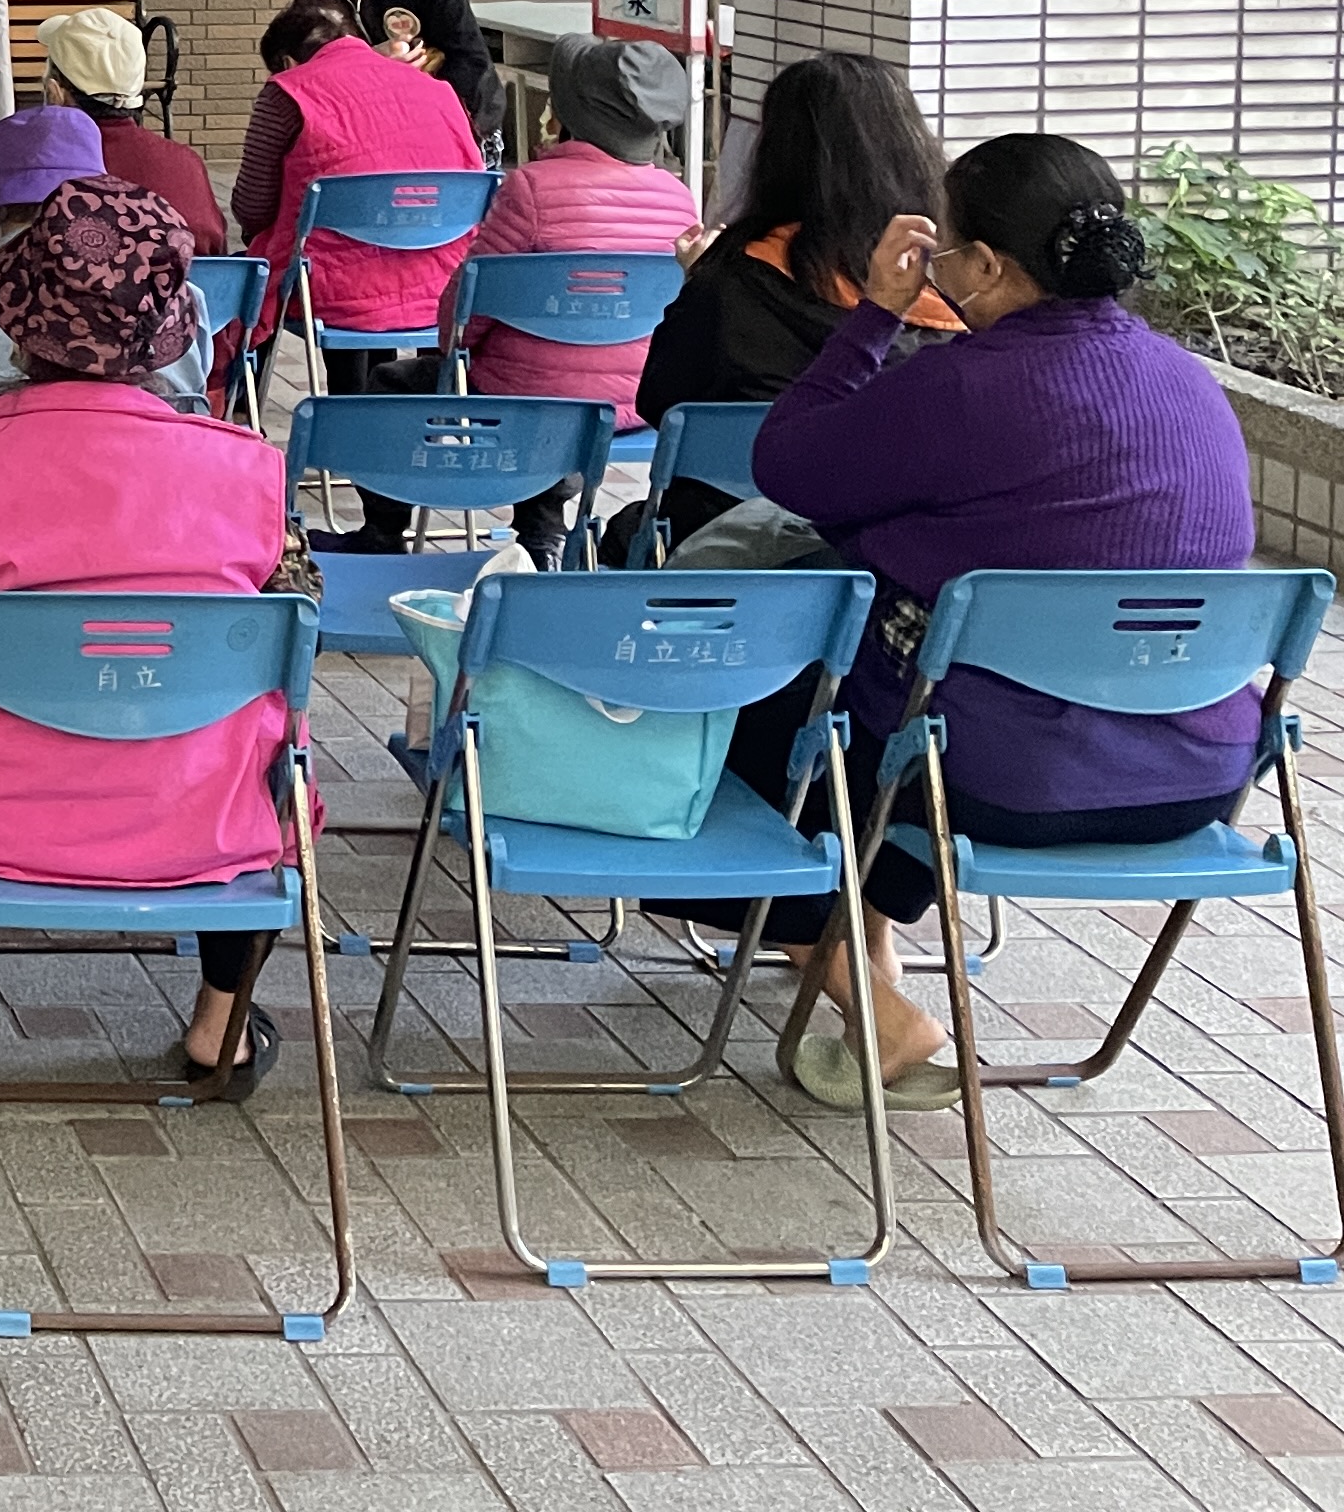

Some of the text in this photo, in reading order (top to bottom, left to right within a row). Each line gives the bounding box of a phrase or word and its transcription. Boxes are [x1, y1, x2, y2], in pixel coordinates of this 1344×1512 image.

[412, 447, 519, 472] 自立社區
[615, 633, 748, 666] 自立社區
[98, 663, 162, 692] 自立
